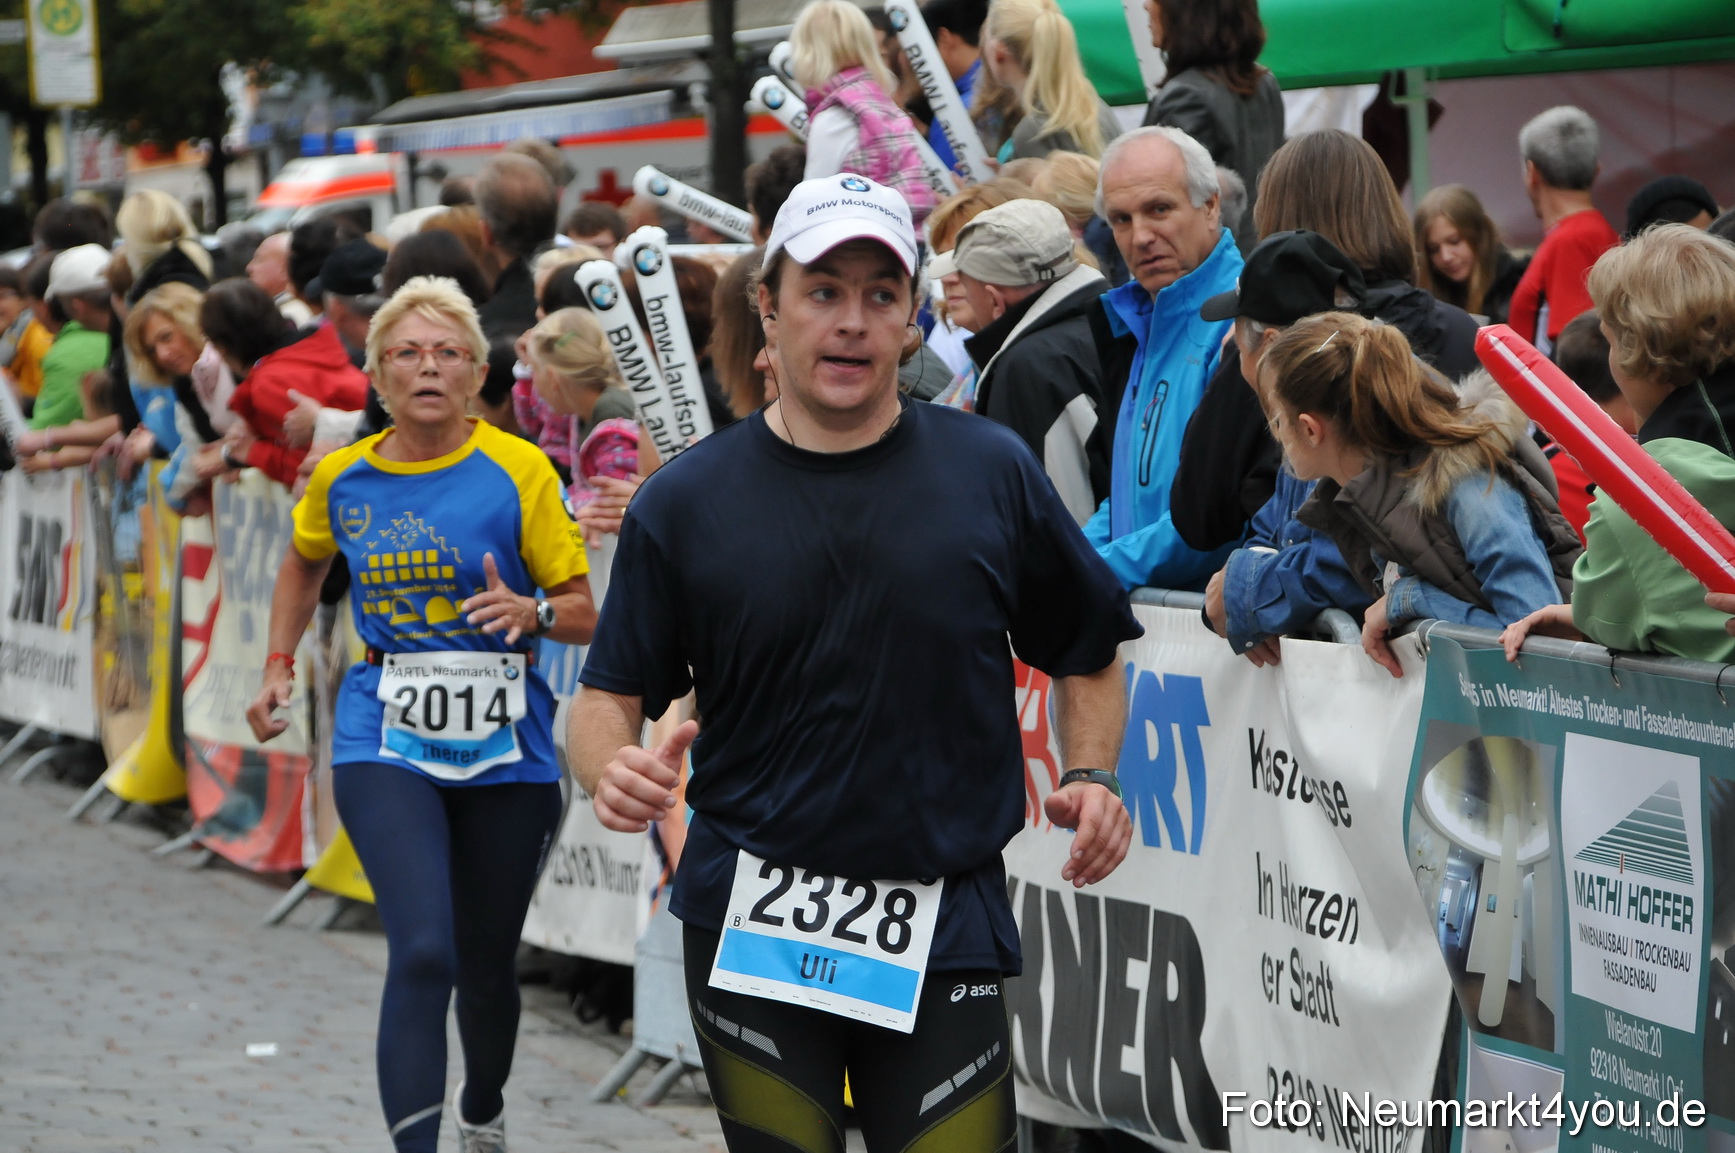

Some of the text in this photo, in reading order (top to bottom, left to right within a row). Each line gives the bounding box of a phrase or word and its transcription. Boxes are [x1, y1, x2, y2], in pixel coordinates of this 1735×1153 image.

[806, 198, 904, 226] BMW Motorsport
[606, 323, 684, 460] BMW Lauf
[385, 665, 498, 678] PARTL Neumarkt
[393, 683, 511, 731] 2014
[1479, 683, 1497, 707] in
[1496, 683, 1548, 713] Neumarkt!
[1549, 684, 1584, 720] Ältestes
[1584, 695, 1622, 727] Trocken-
[1623, 704, 1641, 731] und
[421, 743, 480, 764] Theres
[733, 915, 742, 928] B
[748, 859, 918, 955] 2328
[1256, 851, 1359, 945] In Herzen
[1574, 870, 1694, 935] MATHI HOFFER
[800, 953, 837, 985] Uli
[1579, 922, 1628, 957] INNENAUSBAU
[1635, 939, 1692, 972] TROCKENBAU
[1290, 947, 1340, 1027] Stadt
[1603, 958, 1657, 993] FASSADENBAU
[1590, 1047, 1618, 1085] 92318
[1619, 1057, 1661, 1101] Neumarkt
